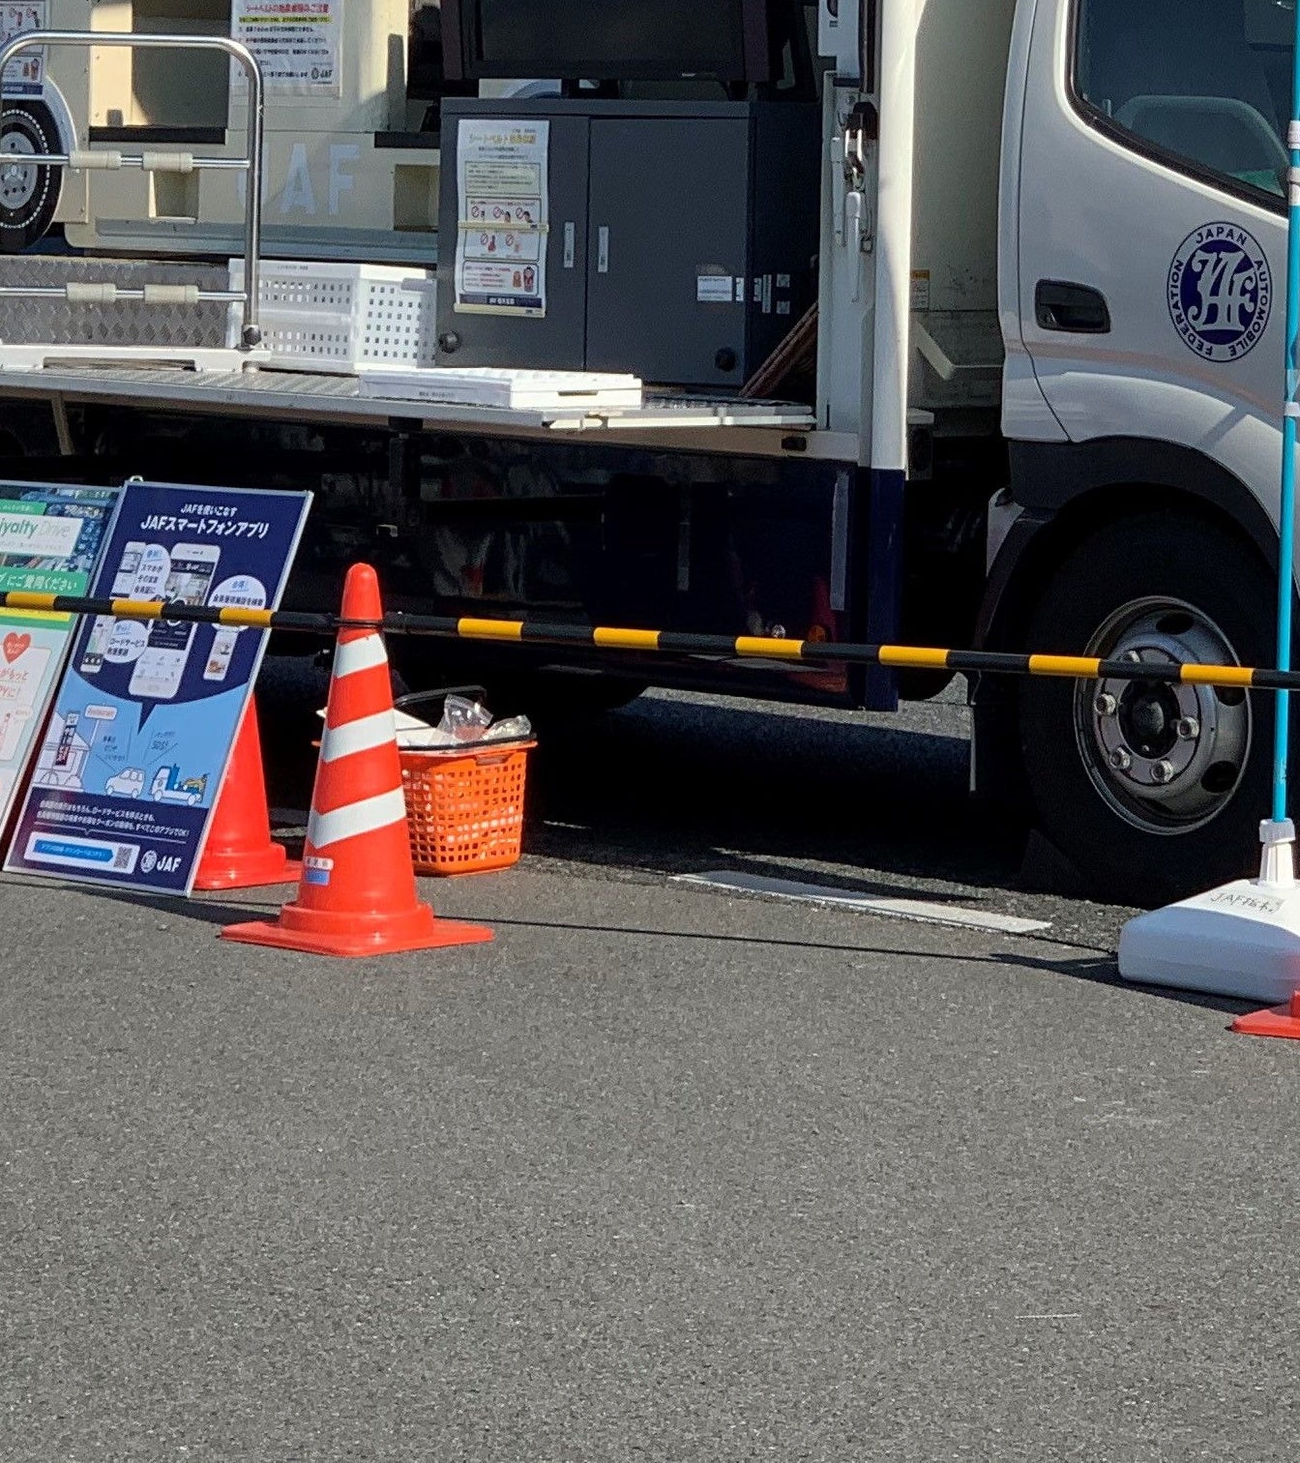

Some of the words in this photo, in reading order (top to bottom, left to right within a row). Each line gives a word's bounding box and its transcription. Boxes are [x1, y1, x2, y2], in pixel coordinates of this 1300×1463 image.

[1195, 226, 1248, 246] JAPAN
[1170, 259, 1214, 357] FEDERATION
[1228, 259, 1269, 357] AUTOMOBILE
[140, 515, 270, 539] JAFスマートフォンアプリ
[156, 855, 182, 873] JAF
